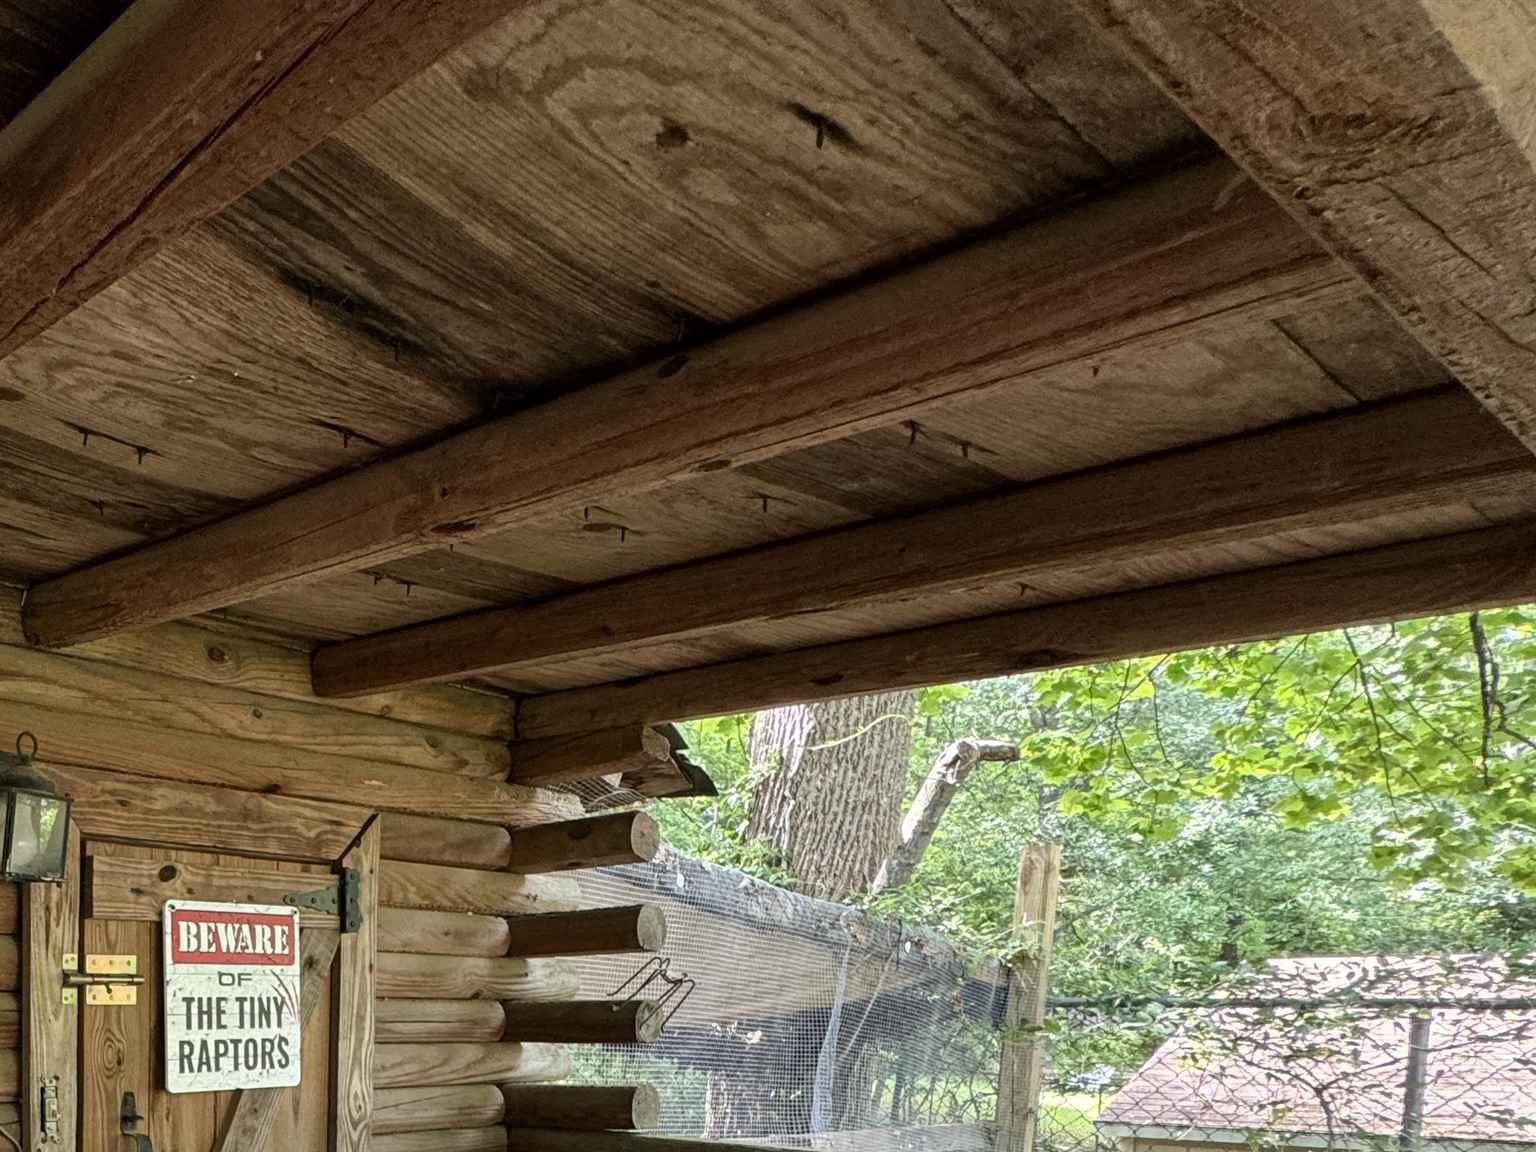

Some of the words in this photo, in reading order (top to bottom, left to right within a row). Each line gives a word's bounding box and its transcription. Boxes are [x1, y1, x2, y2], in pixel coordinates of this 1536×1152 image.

[177, 921, 289, 954] BEWARE
[218, 971, 253, 987] OF
[182, 997, 227, 1030] THE
[235, 997, 287, 1029] TINY
